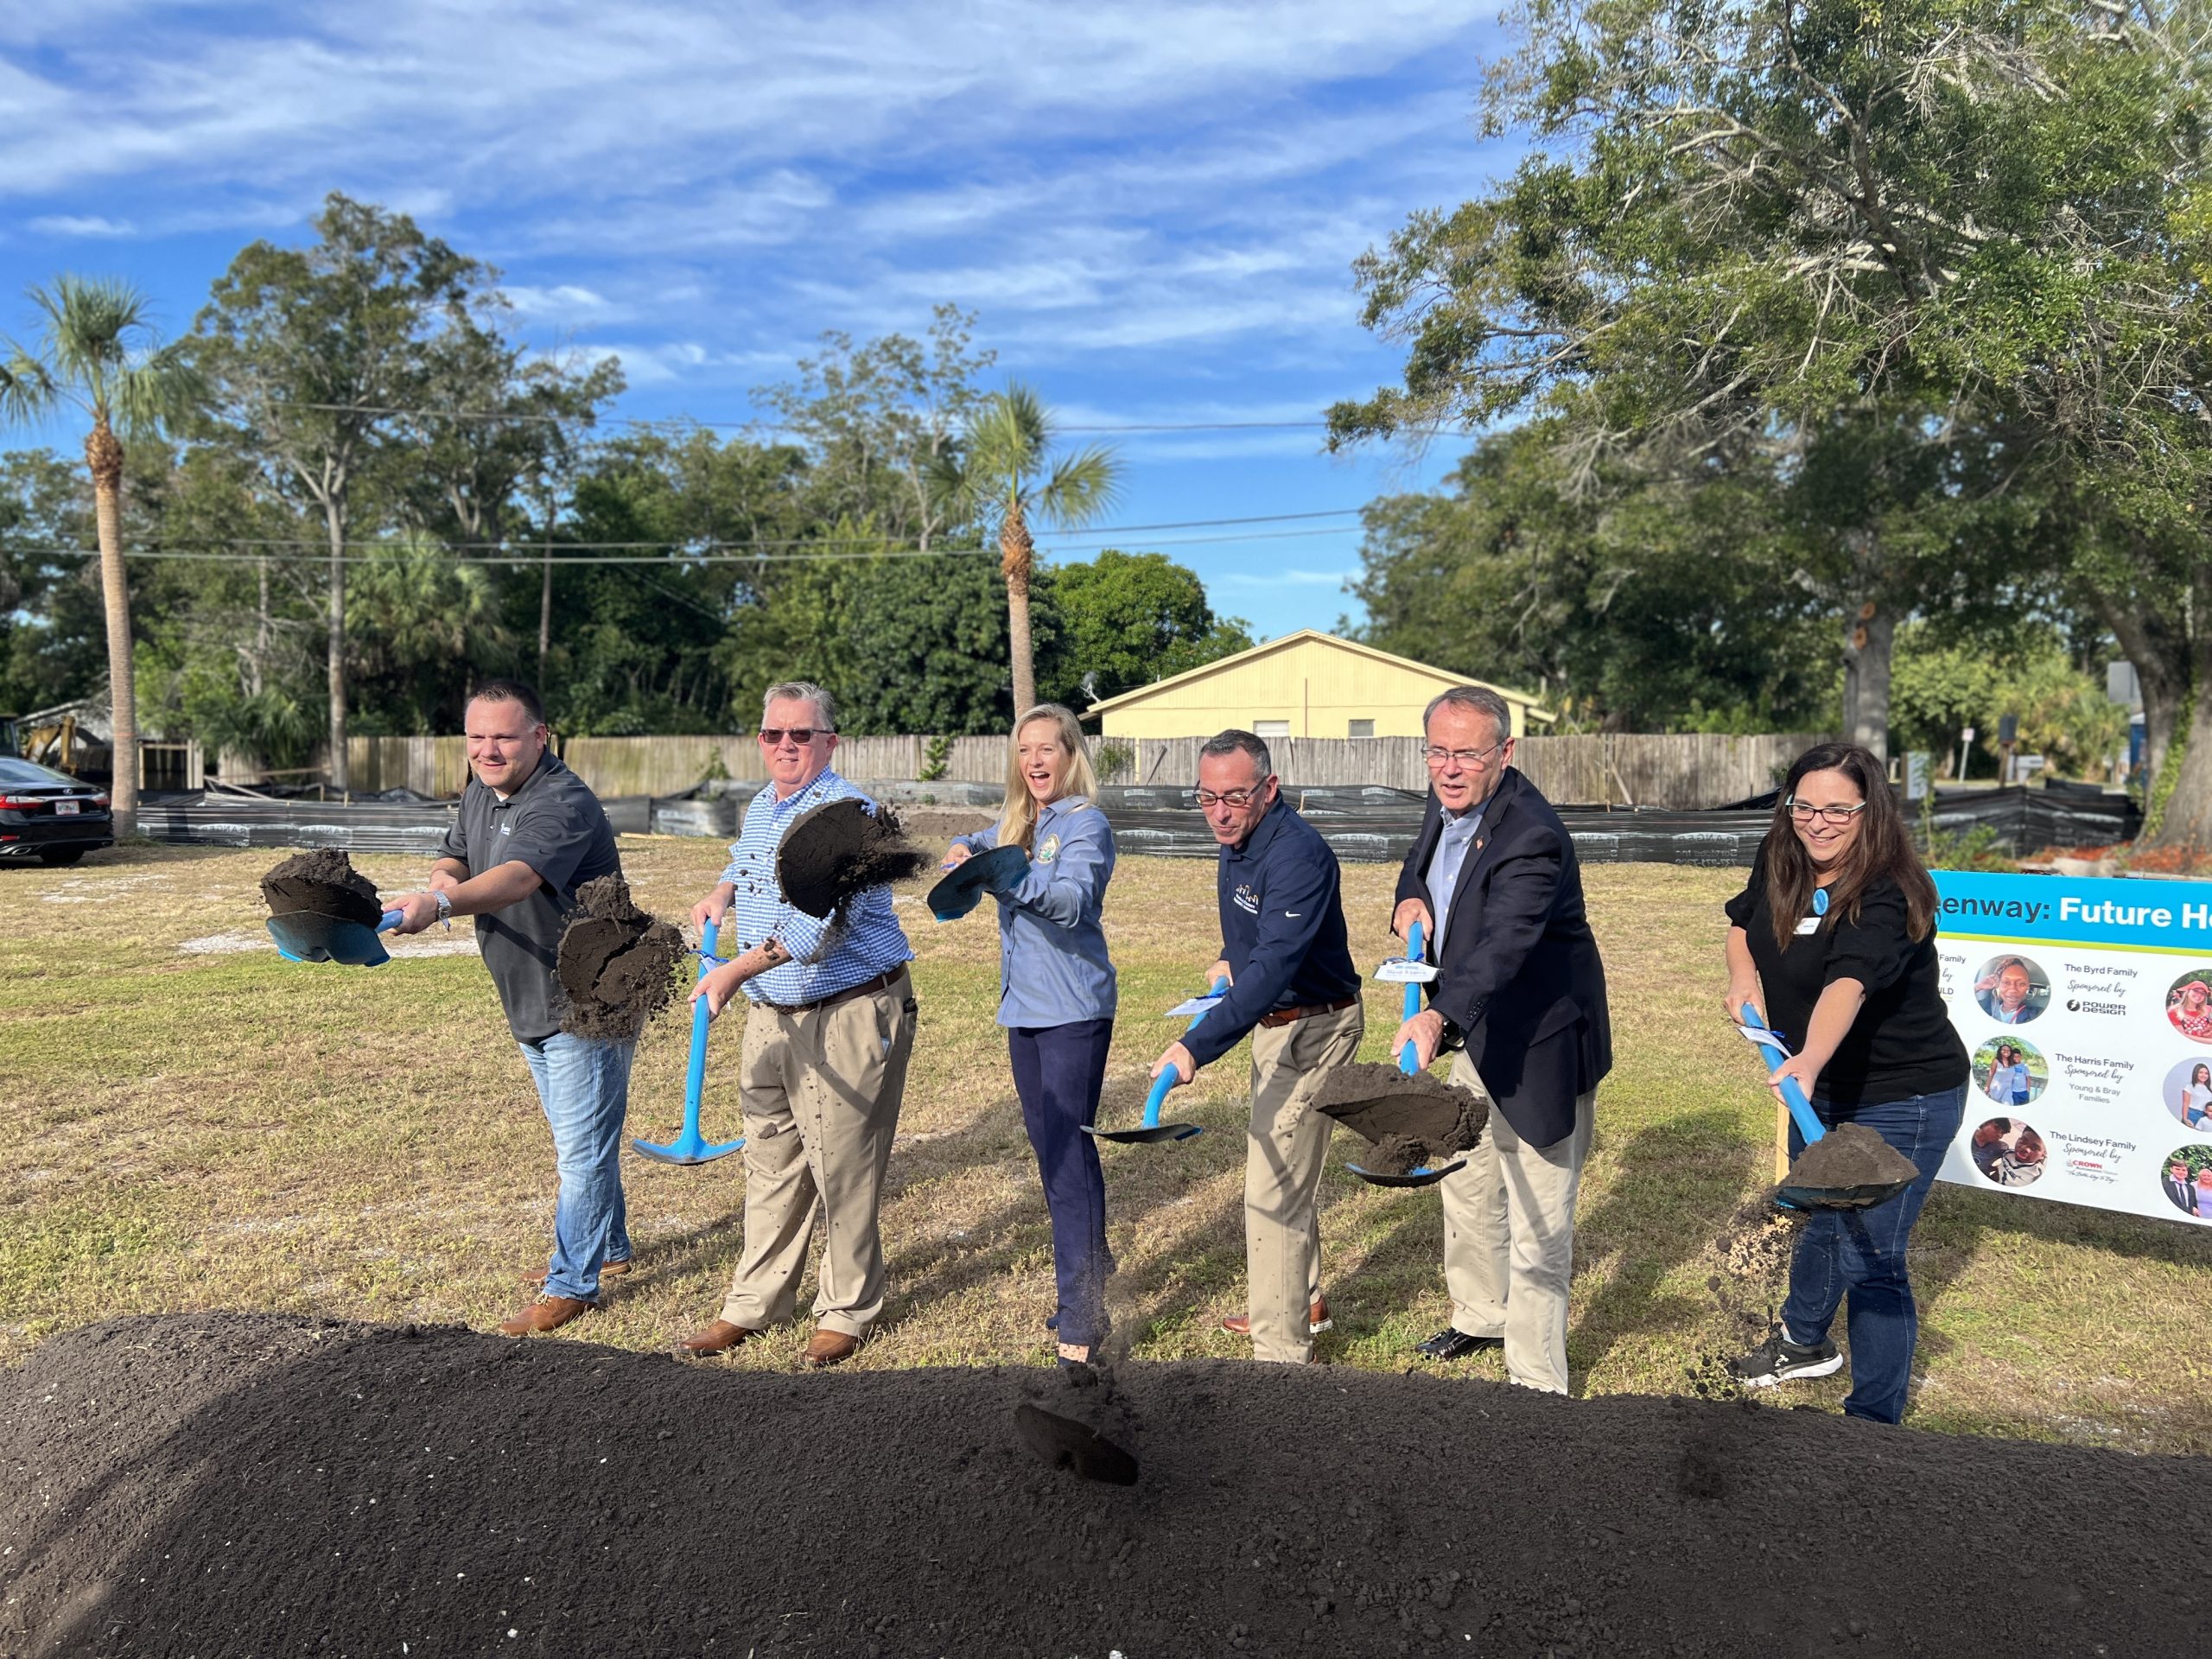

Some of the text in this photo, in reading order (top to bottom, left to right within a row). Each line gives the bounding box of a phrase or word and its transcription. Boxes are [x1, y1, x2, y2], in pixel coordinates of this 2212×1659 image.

[1942, 897, 2212, 930] enway: Future H
[1939, 954, 1967, 964] Family
[1942, 968, 1953, 982] by
[2063, 963, 2138, 978] The Byrd Family
[2067, 979, 2127, 998] Sponsored by
[2056, 1053, 2134, 1071] The Harris Family
[2064, 1064, 2125, 1084] Sponsored by
[2069, 1083, 2094, 1093] Young
[2102, 1087, 2120, 1096] Bray
[2079, 1094, 2110, 1103] Families
[2050, 1130, 2137, 1152] The Lindsey Family
[2063, 1142, 2123, 1164] Sponsored by
